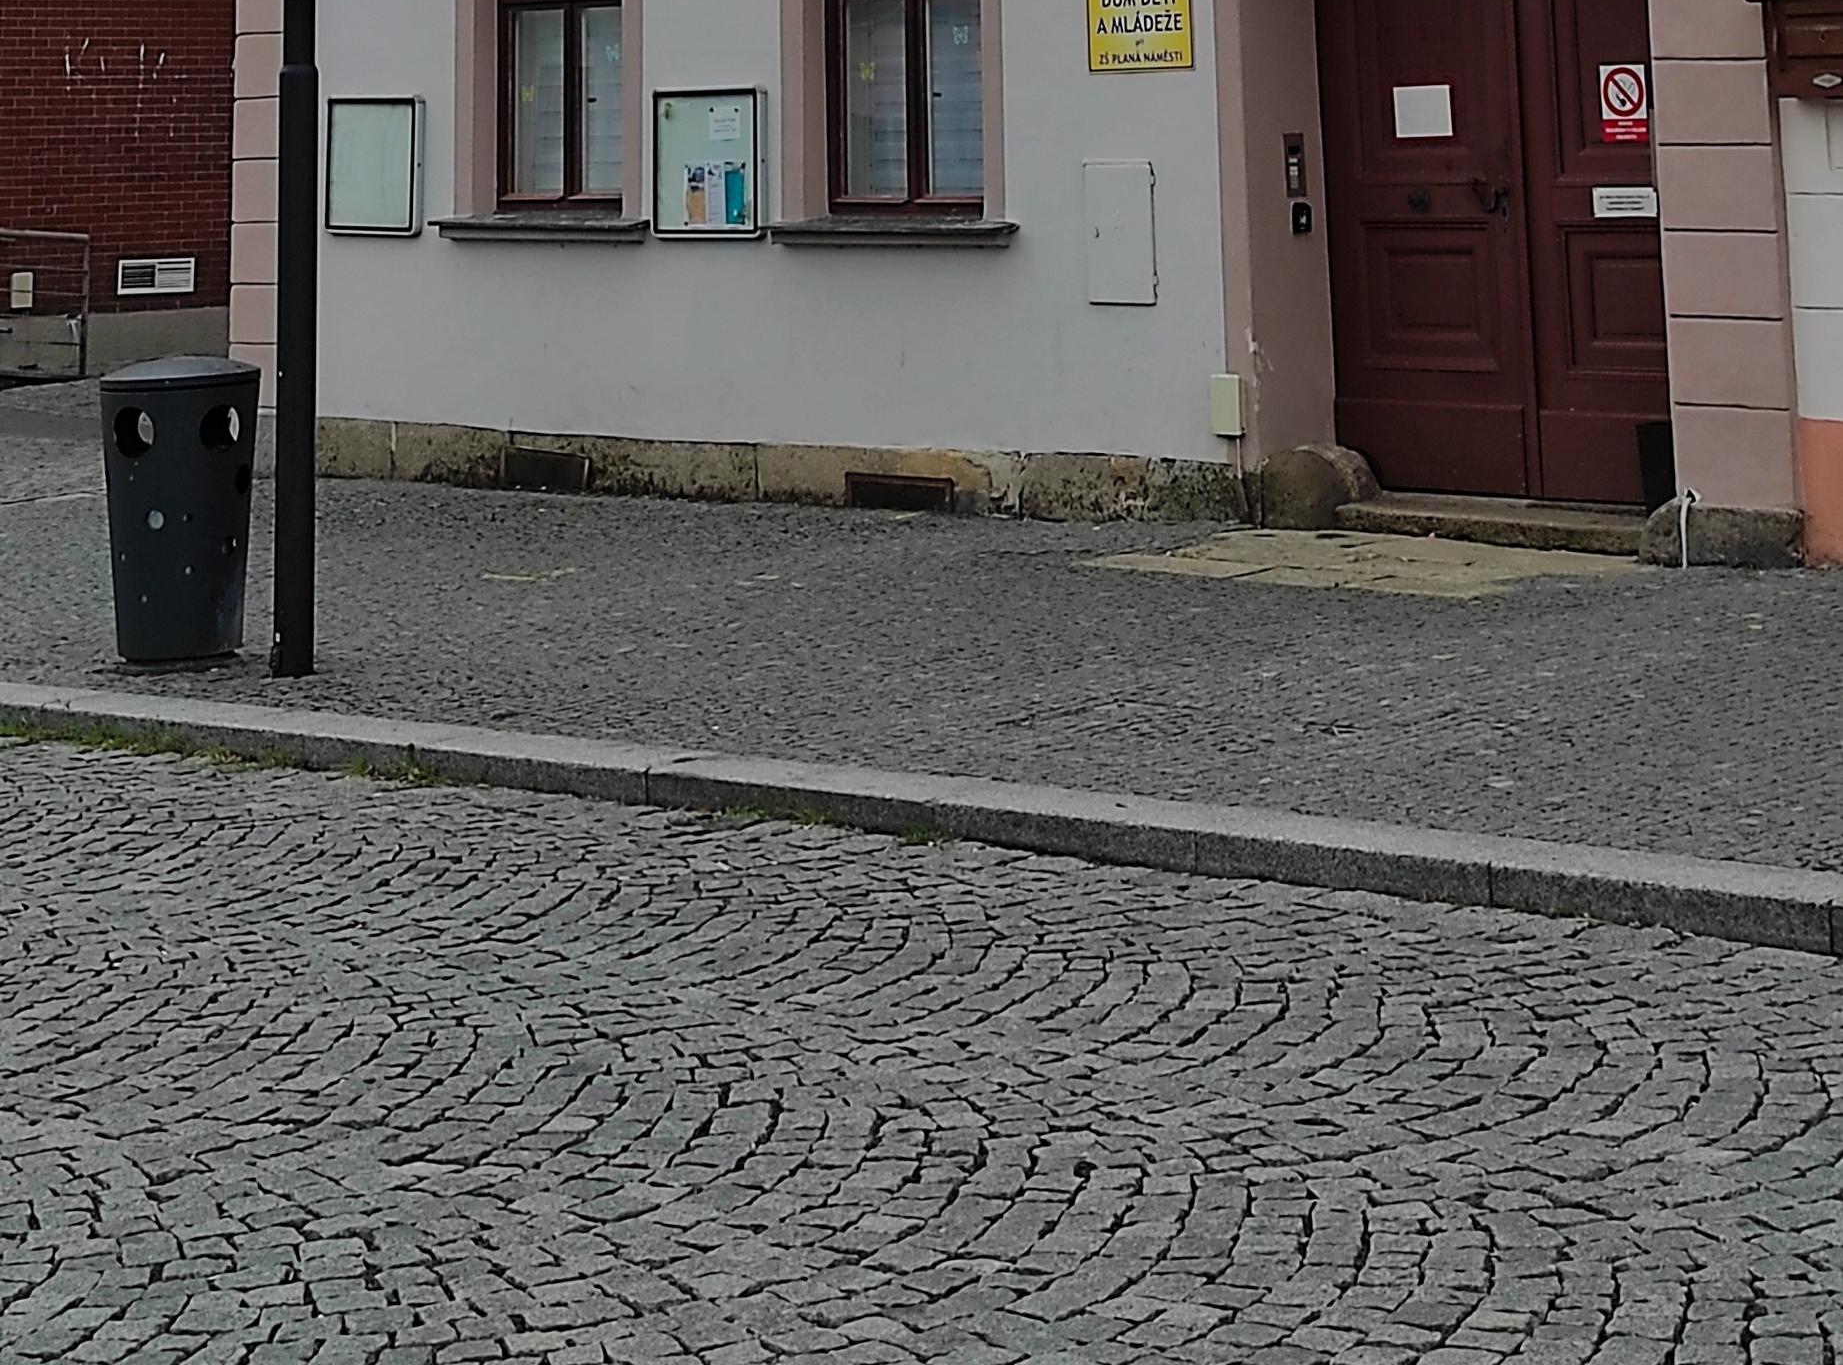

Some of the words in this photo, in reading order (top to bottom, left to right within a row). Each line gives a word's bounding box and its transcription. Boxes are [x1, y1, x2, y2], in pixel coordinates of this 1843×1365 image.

[1096, 17, 1108, 35] A
[1111, 10, 1183, 34] MLÁDEŽE
[1099, 51, 1110, 65] ZŠ
[1112, 49, 1141, 64] PLANÁ
